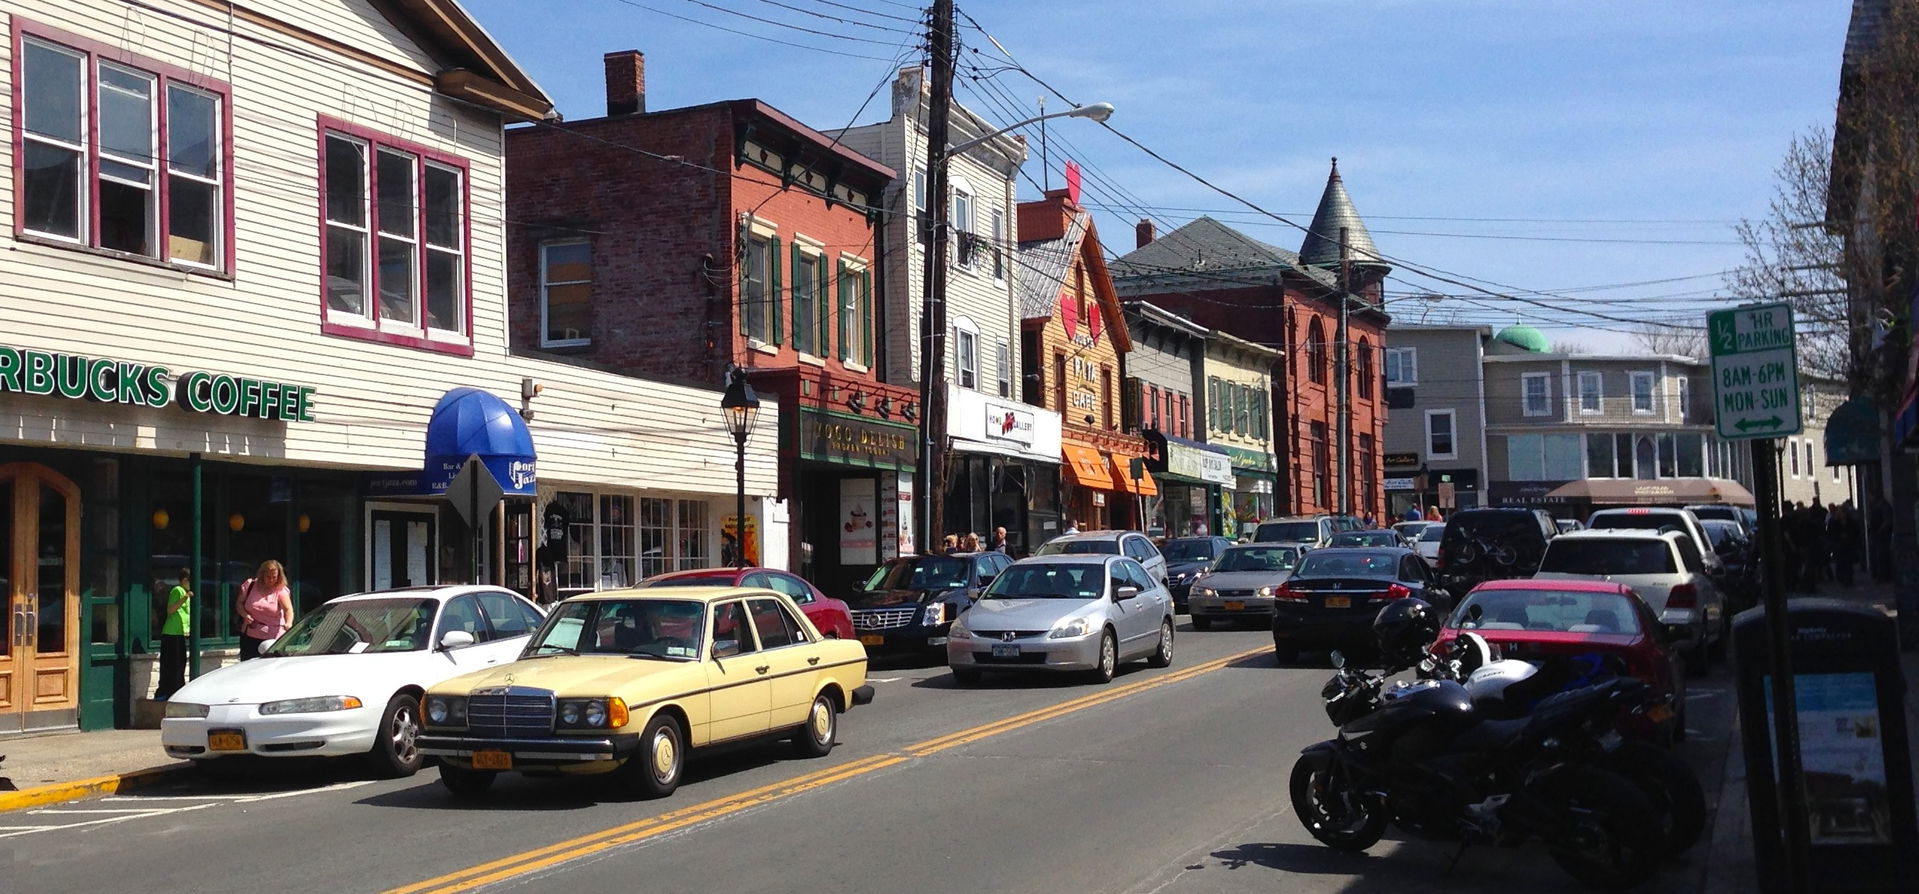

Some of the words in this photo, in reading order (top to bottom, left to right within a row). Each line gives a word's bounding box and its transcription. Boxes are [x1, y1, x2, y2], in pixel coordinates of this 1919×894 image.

[1750, 311, 1773, 329] HR
[1737, 327, 1790, 349] PARKING
[1722, 361, 1786, 388] 8AM-6PM
[186, 370, 317, 422] COFFEE
[1723, 387, 1789, 413] MON-SUN
[861, 429, 905, 450] DELISH
[443, 462, 455, 470] Bar
[514, 472, 536, 489] Jaz
[1502, 496, 1527, 504] REAL
[1530, 496, 1567, 504] ESTATE
